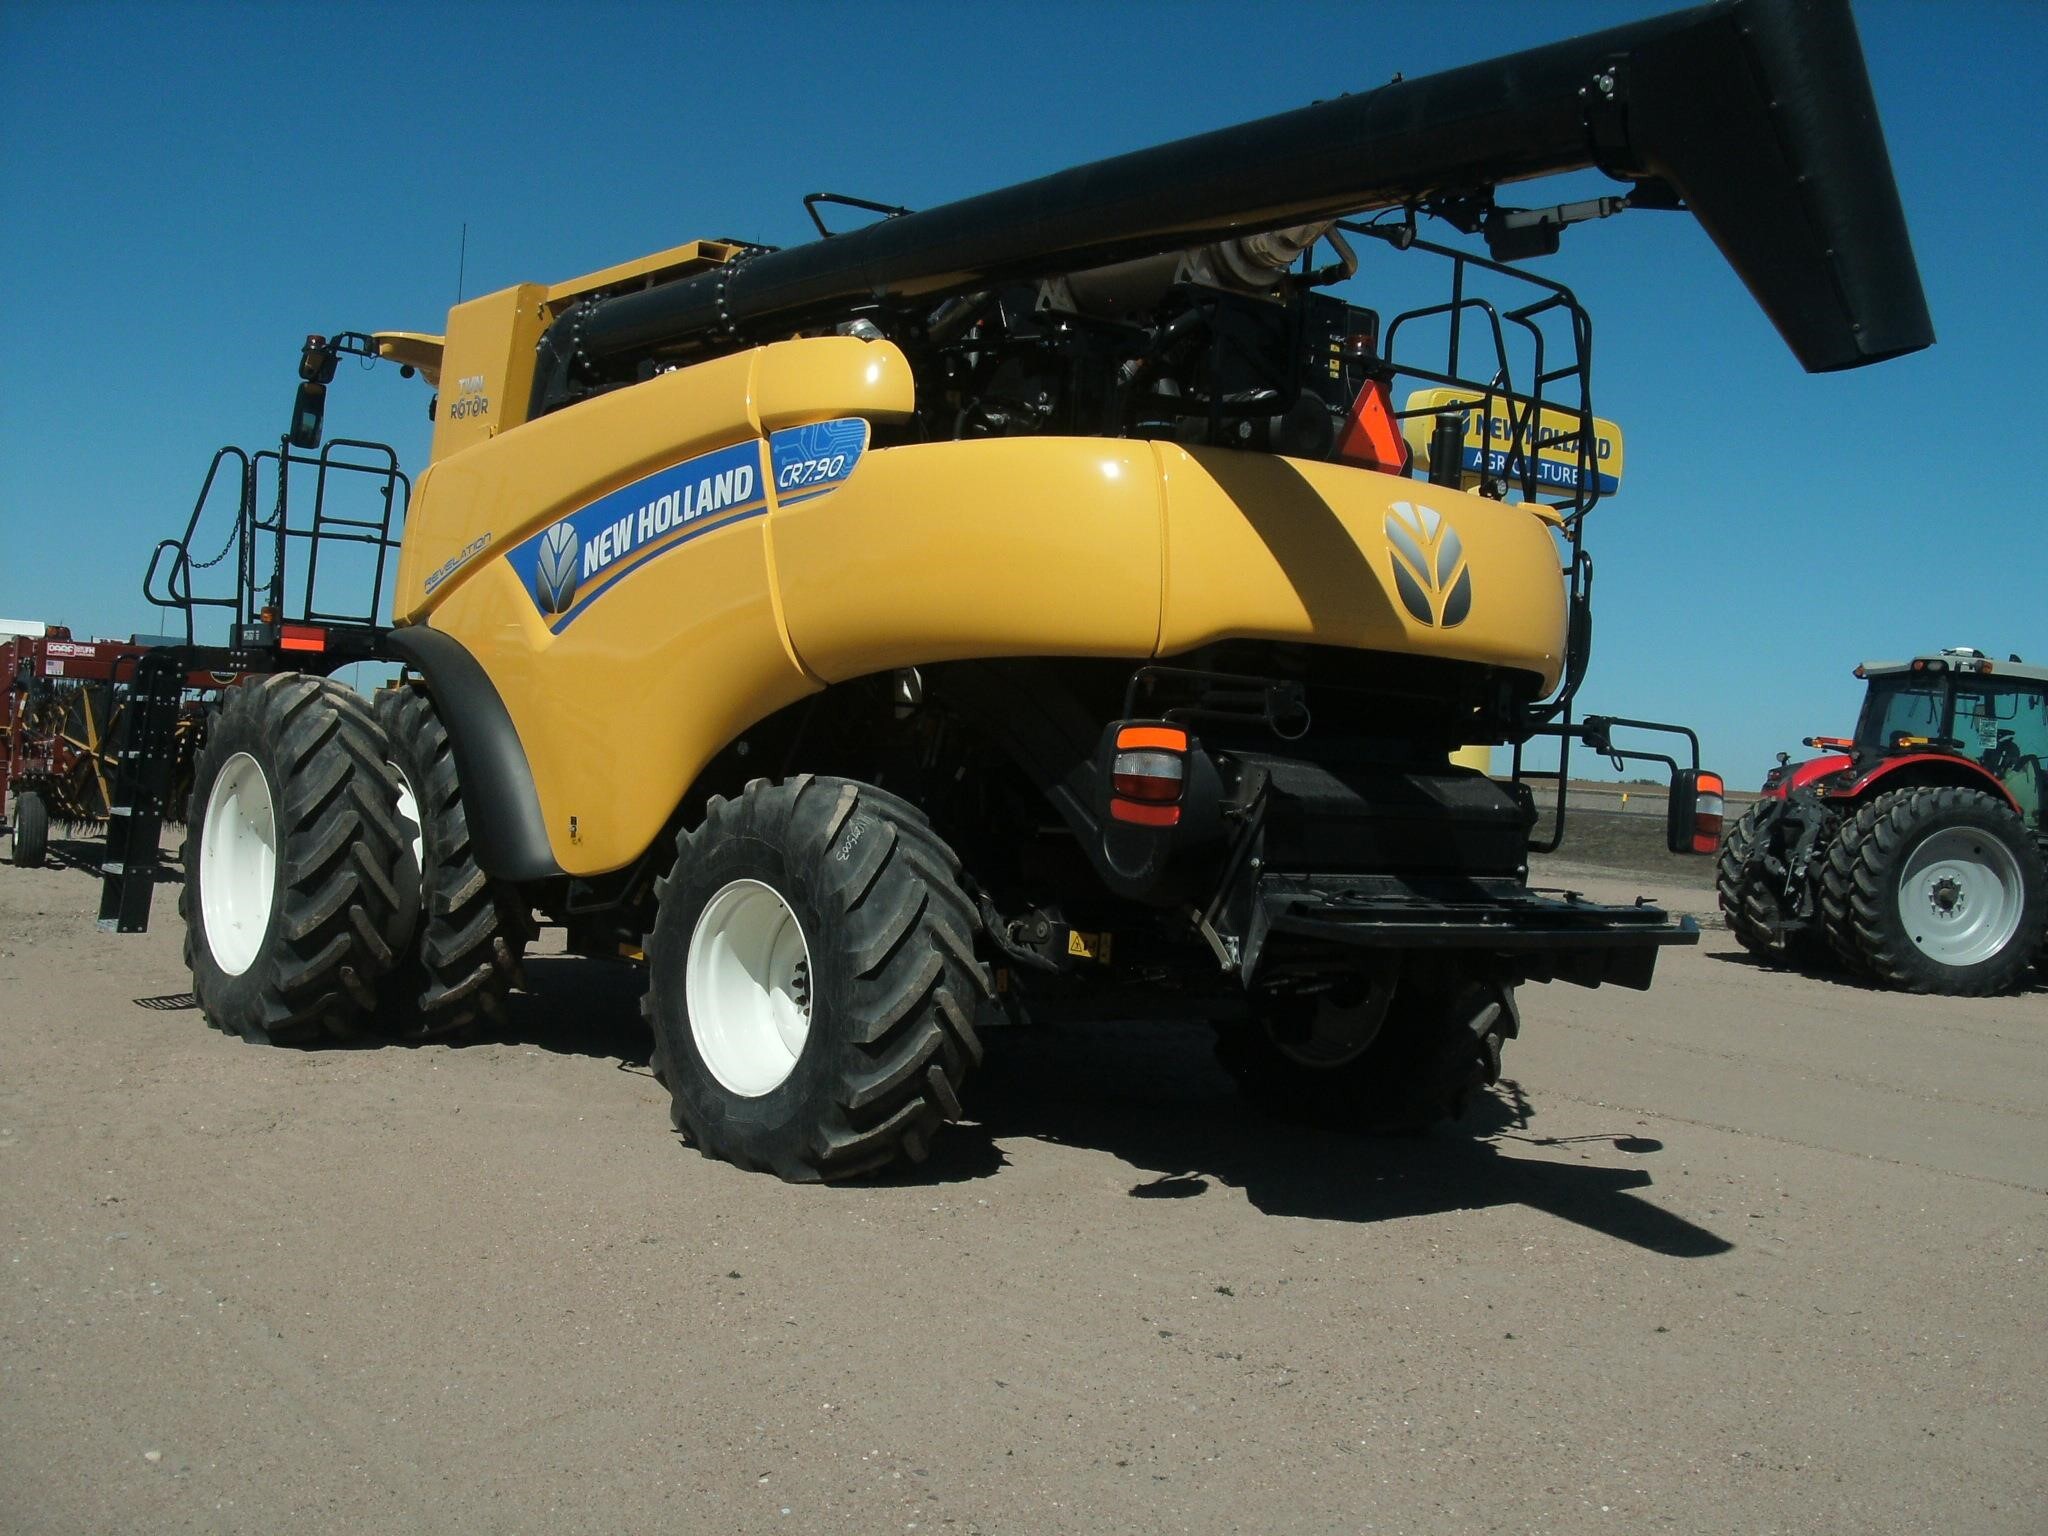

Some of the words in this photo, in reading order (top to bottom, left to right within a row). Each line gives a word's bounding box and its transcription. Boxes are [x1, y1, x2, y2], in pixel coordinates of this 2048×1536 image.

[450, 395, 489, 420] ROTOR
[779, 454, 845, 489] CR7.90
[1472, 451, 1579, 485] AGRCTURE
[583, 513, 634, 580] NEW
[637, 464, 754, 545] HOLLAND
